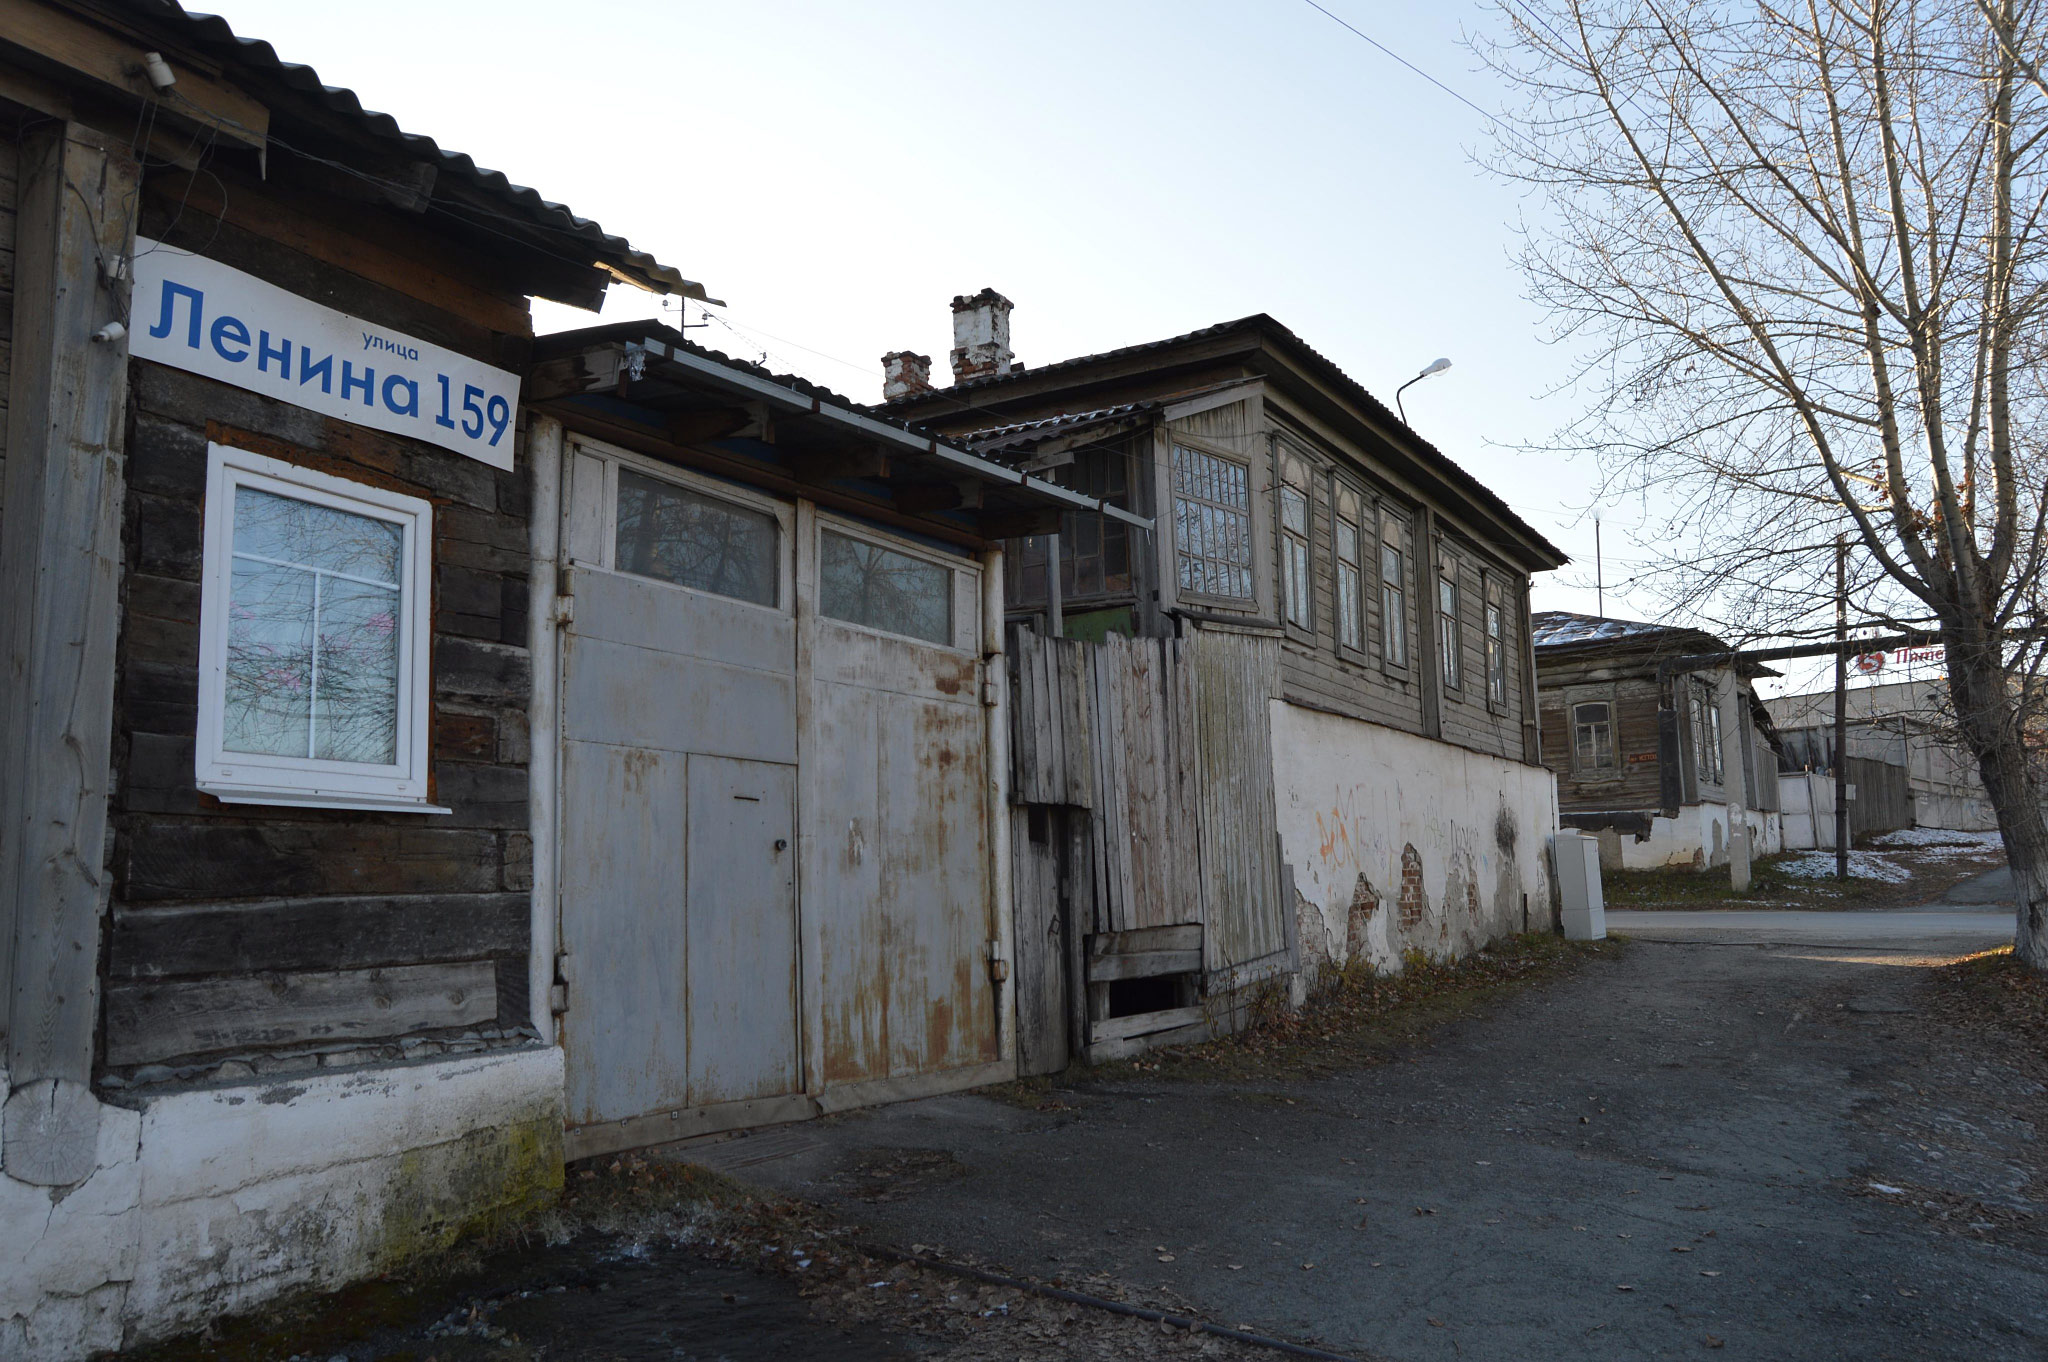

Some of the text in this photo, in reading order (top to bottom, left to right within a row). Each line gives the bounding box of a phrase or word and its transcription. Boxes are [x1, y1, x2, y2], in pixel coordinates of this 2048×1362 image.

[362, 331, 419, 361] улица
[149, 279, 510, 447] Ленина 159
[1895, 647, 1945, 664] Пяте
